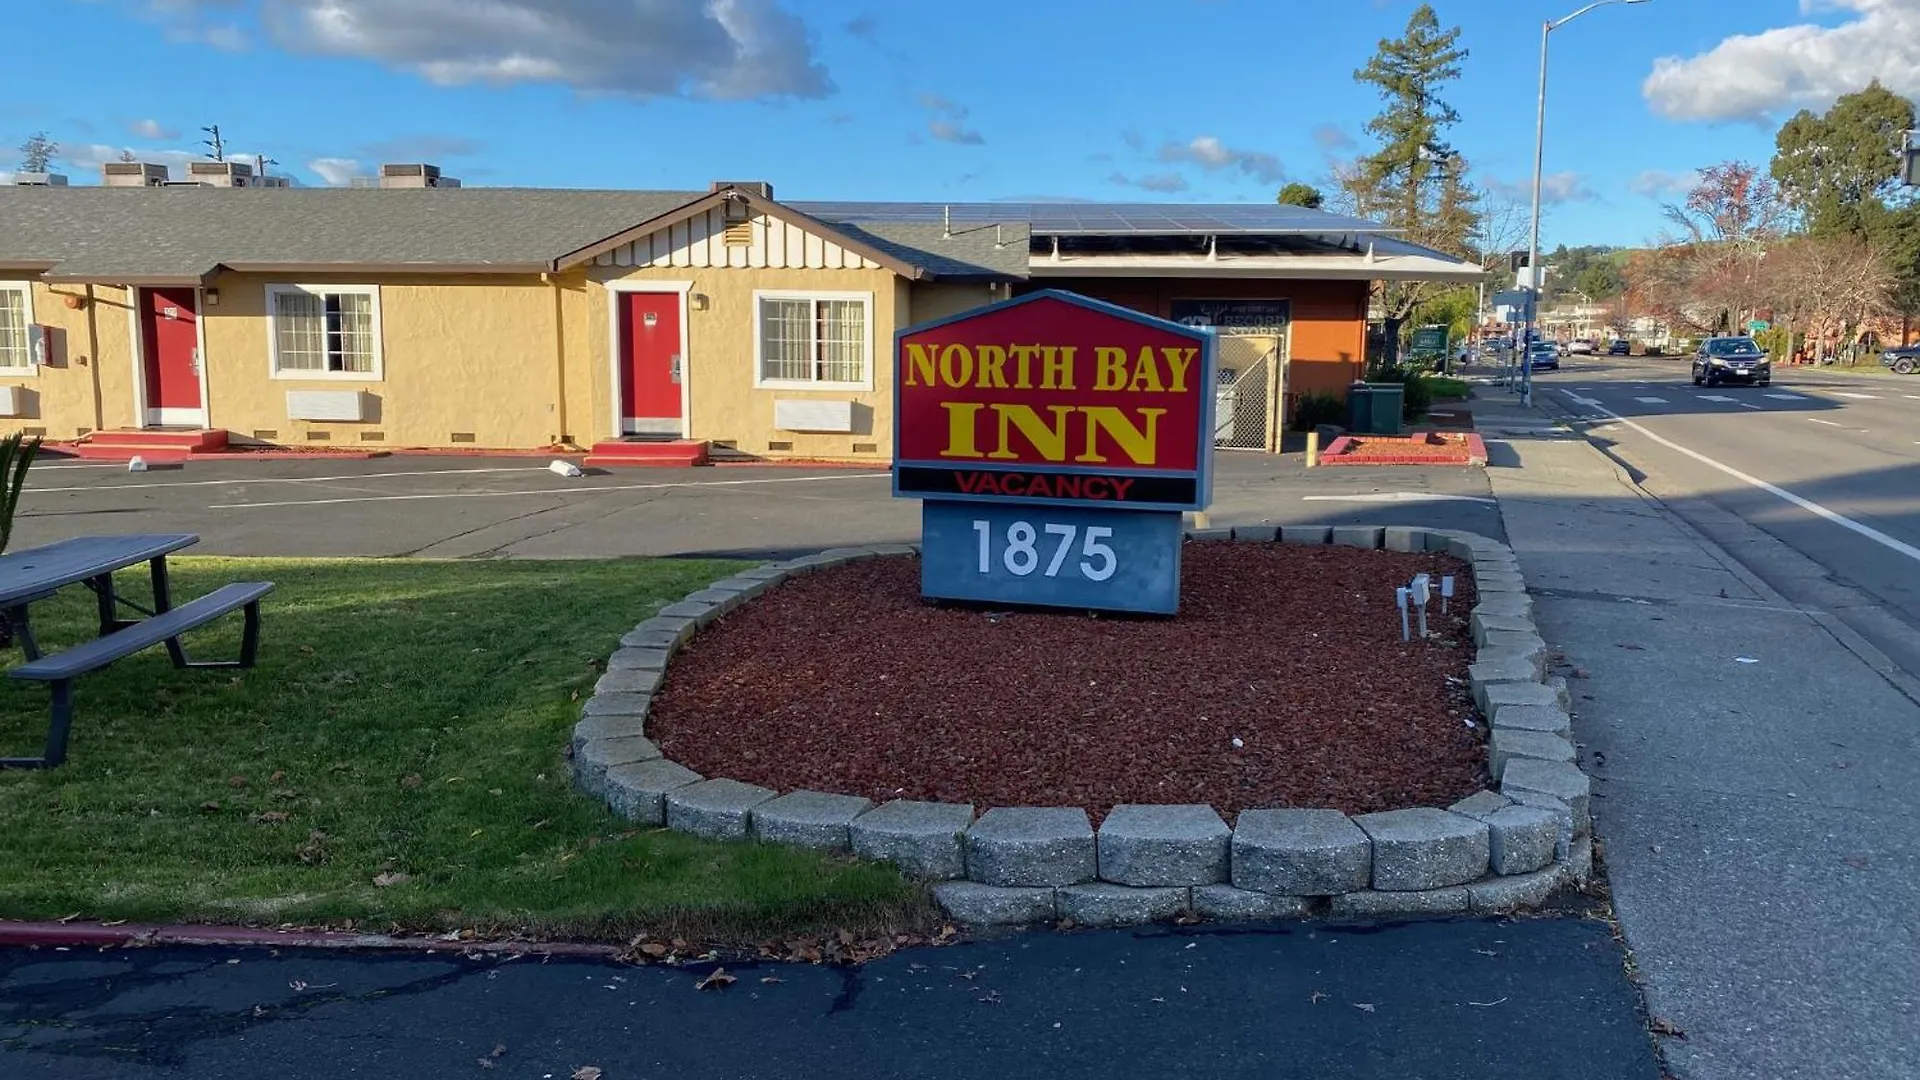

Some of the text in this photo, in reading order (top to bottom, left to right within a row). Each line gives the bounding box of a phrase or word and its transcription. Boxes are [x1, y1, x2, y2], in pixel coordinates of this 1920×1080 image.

[1226, 315, 1285, 327] RECORD
[1229, 327, 1279, 335] STORE
[905, 343, 1199, 393] NORTH BAY
[939, 402, 1168, 465] INN
[954, 471, 1134, 500] VACANCY
[973, 519, 1117, 581] 1875
